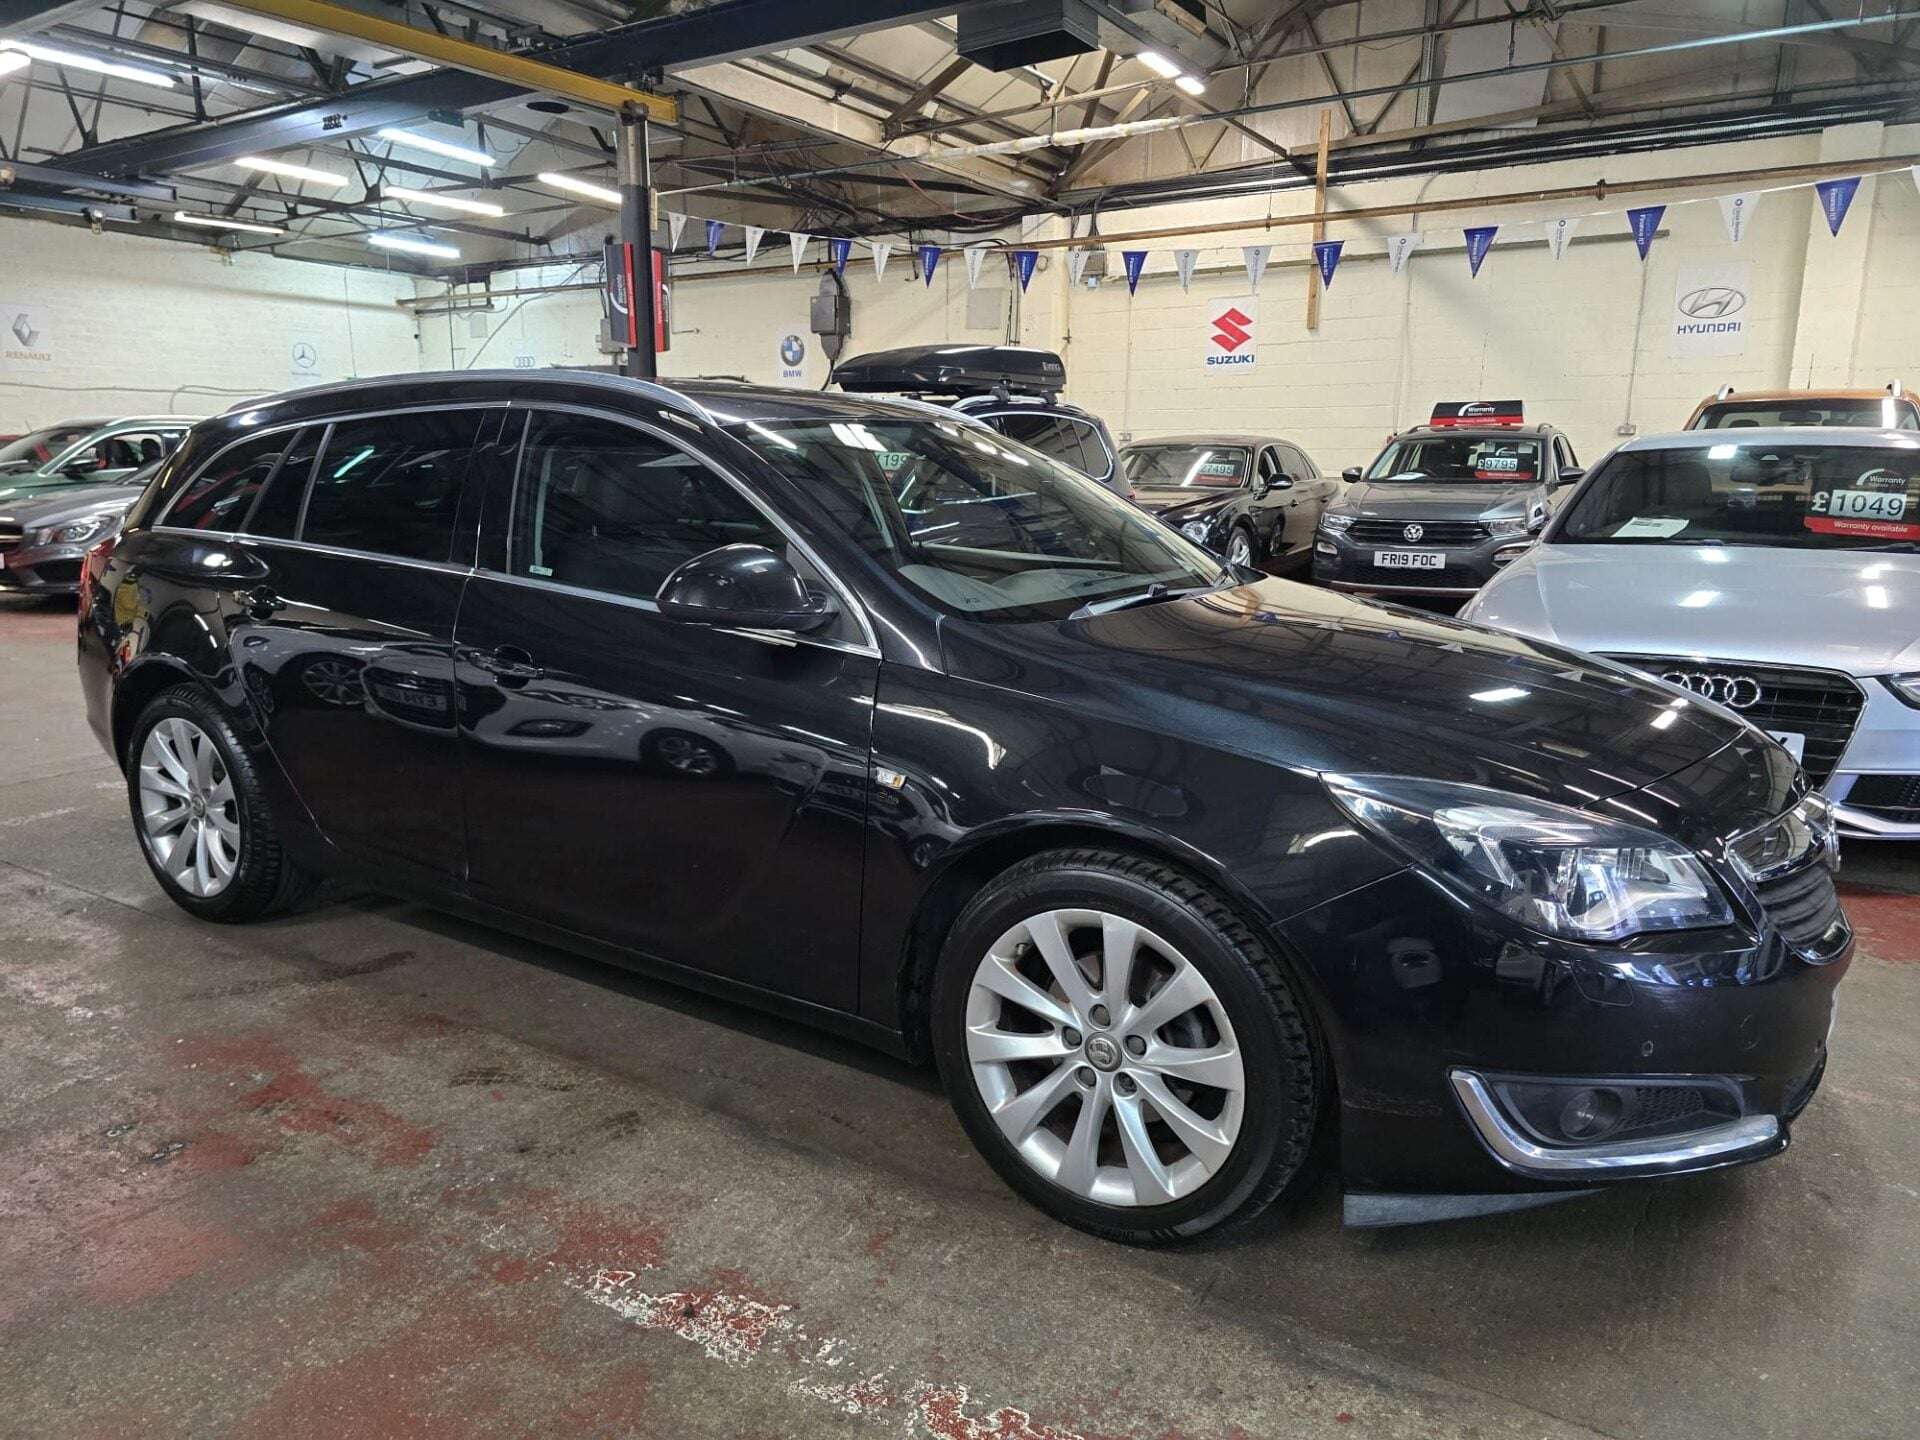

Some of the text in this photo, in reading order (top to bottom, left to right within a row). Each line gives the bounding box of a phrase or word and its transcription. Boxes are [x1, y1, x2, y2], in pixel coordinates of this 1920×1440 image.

[1677, 322, 1742, 335] HYUNDAI
[5, 351, 52, 361] RENAULT
[1207, 354, 1255, 365] SUZUKI
[783, 370, 802, 378] BMW
[1869, 475, 1906, 485] Warranty
[1834, 520, 1908, 533] Warranty available
[1381, 553, 1409, 565] FR19
